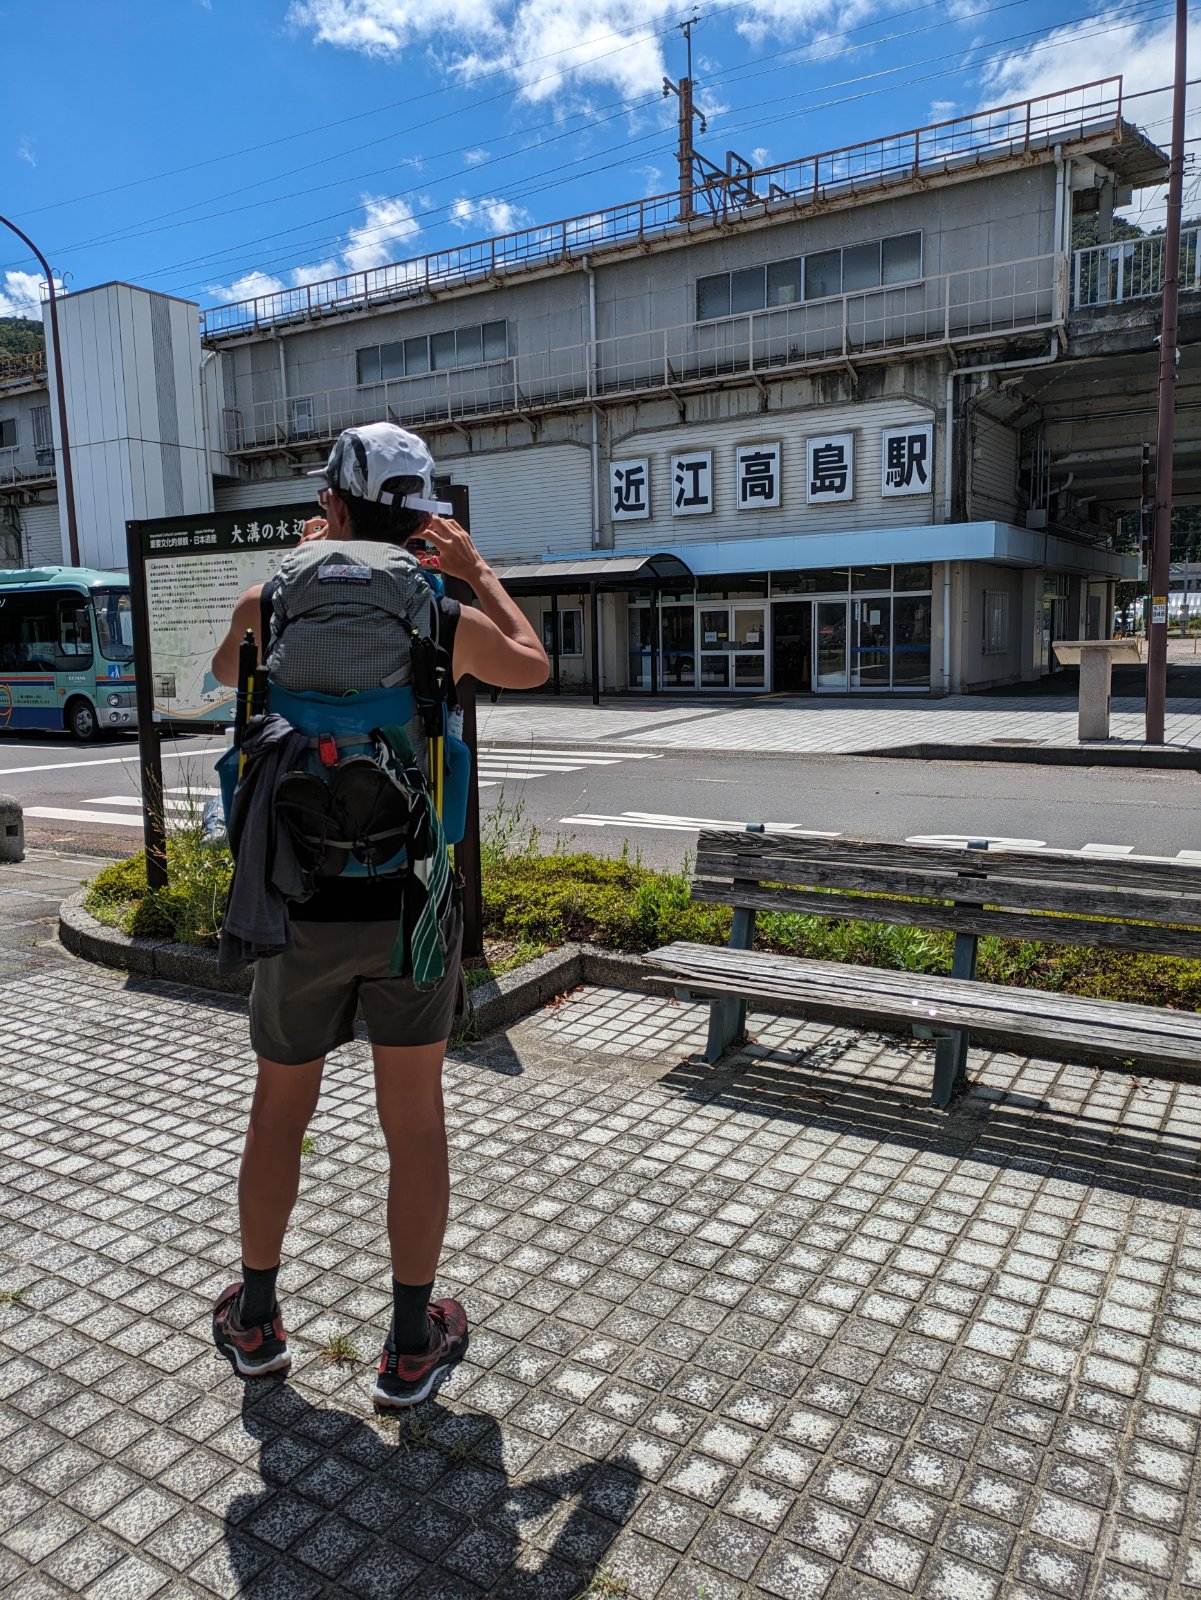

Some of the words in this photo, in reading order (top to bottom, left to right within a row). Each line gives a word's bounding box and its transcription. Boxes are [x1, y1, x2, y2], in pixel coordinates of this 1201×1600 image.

[614, 433, 927, 513] 近江高島駅
[231, 515, 322, 544] 大溝の水辺
